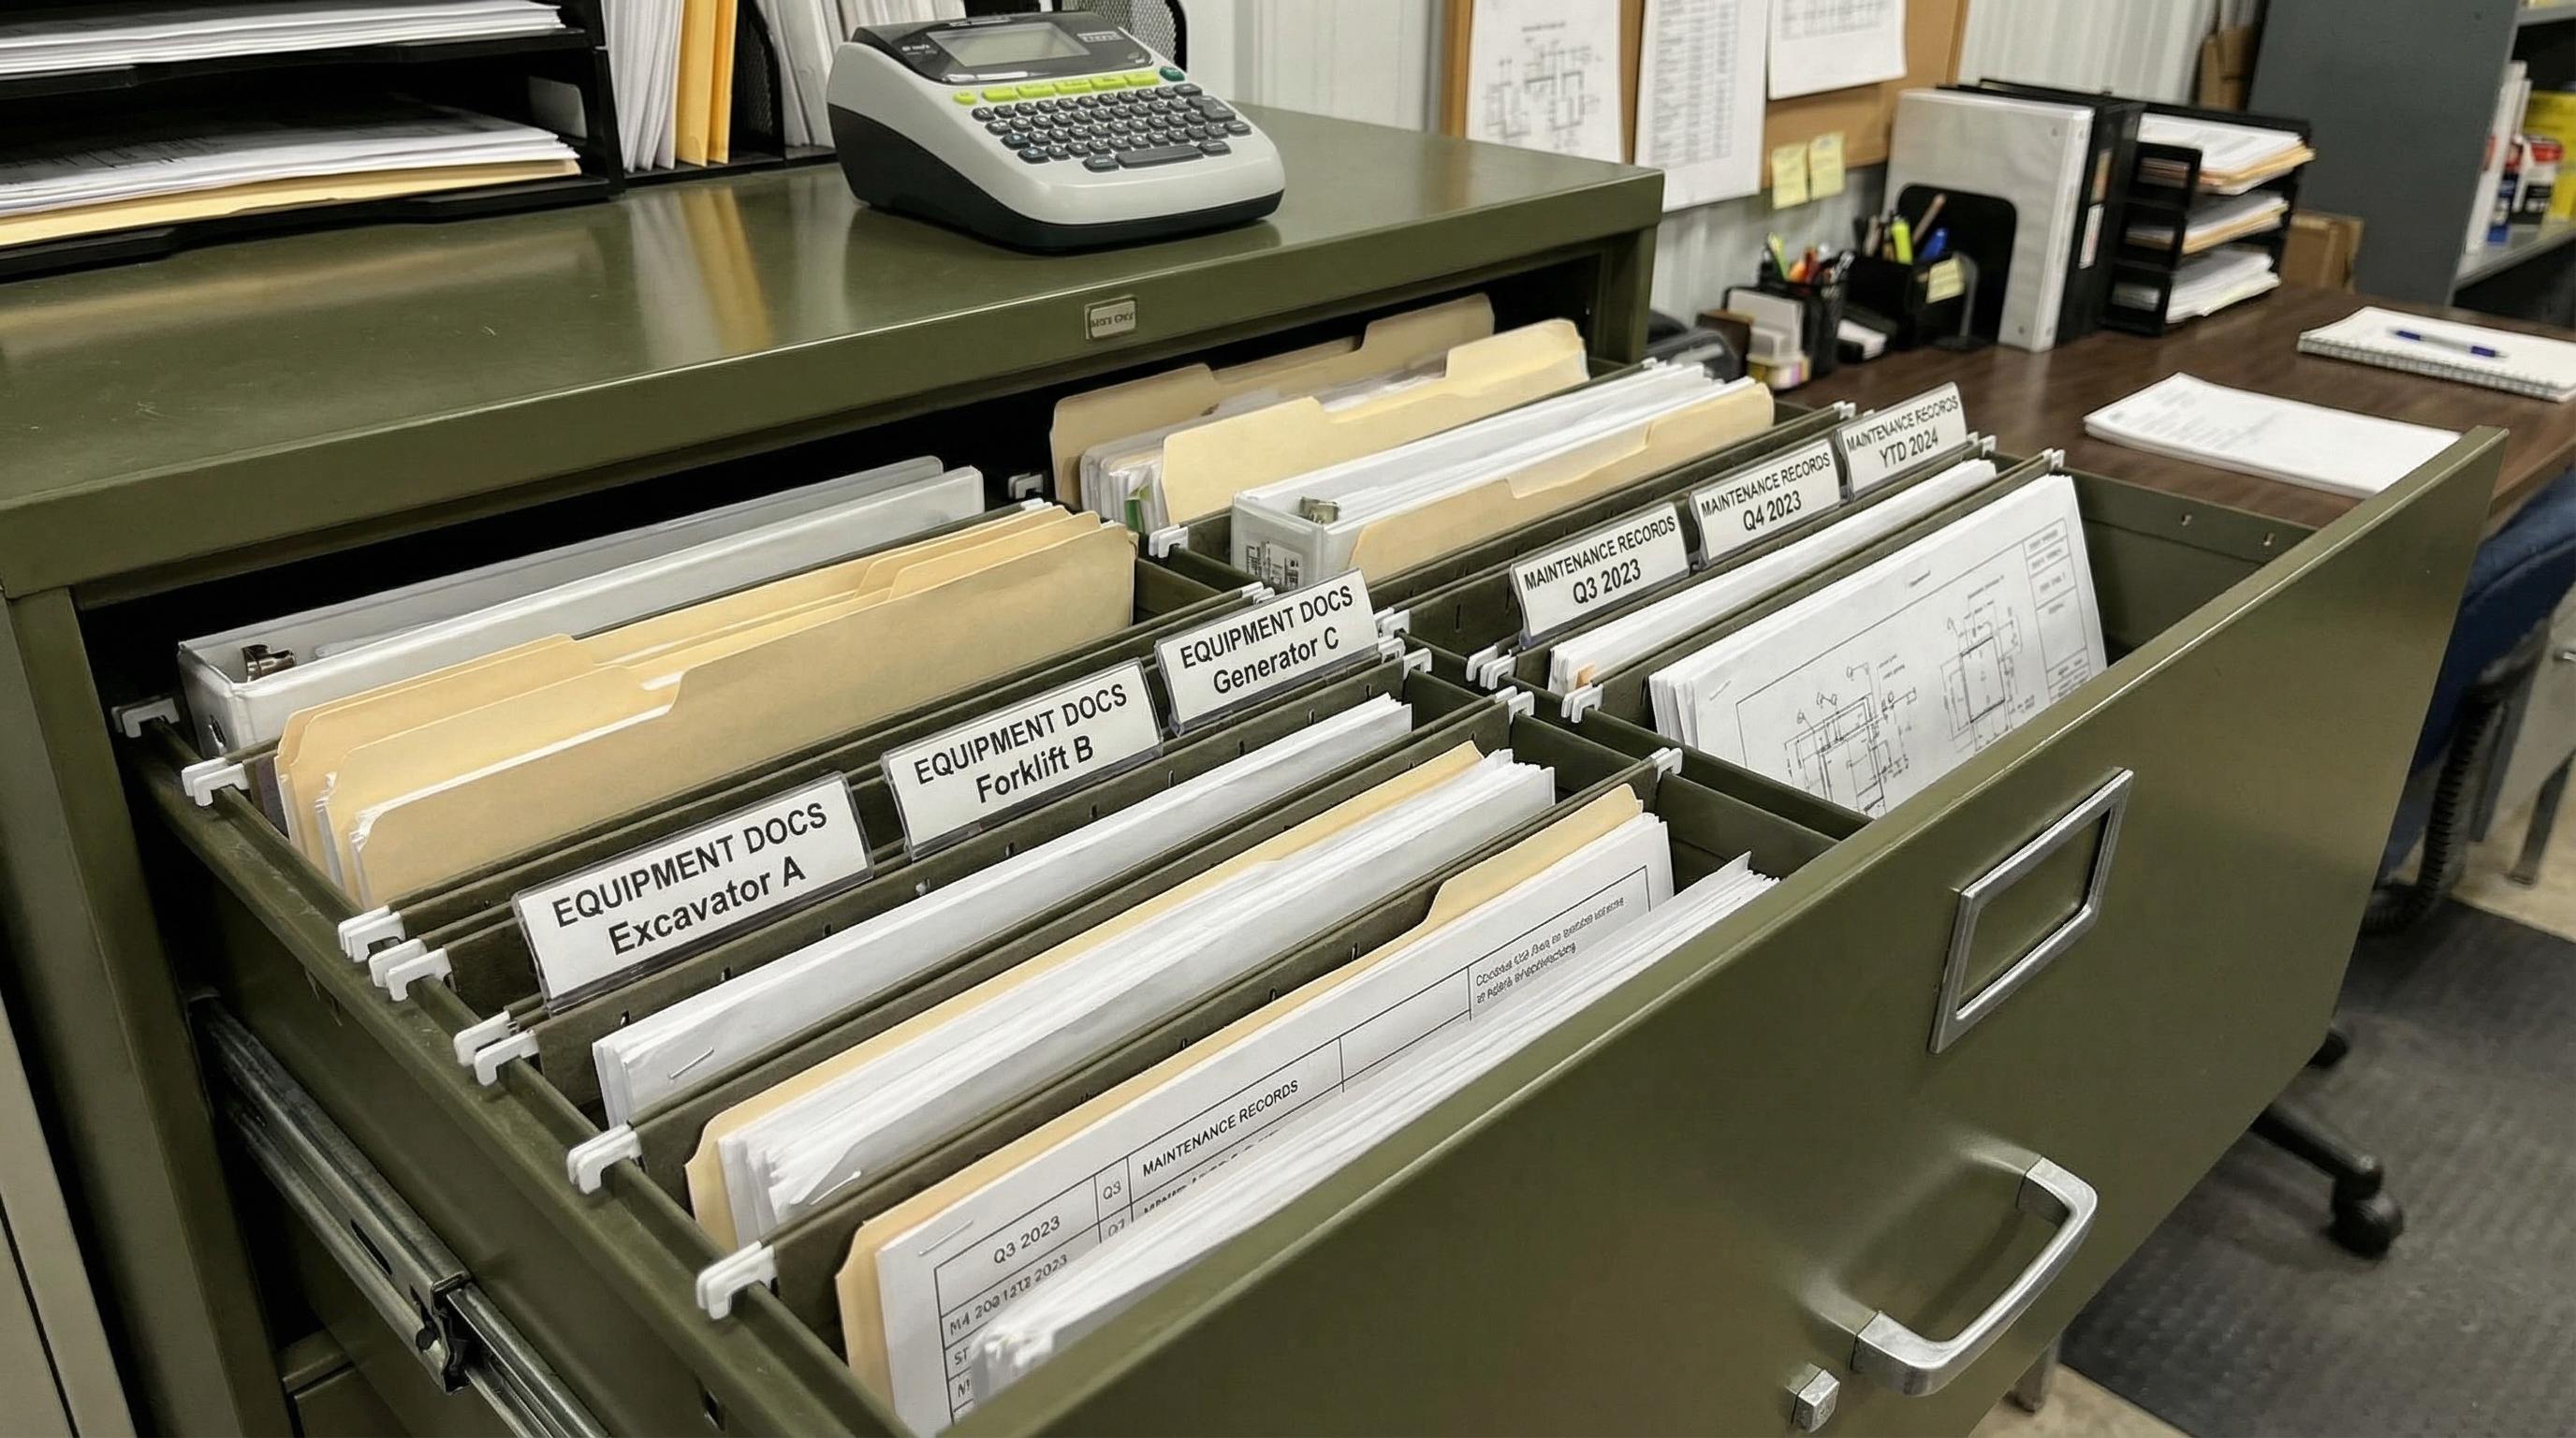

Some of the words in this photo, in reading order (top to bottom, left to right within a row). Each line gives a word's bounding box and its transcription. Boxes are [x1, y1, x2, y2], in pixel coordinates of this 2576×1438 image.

[1846, 412, 1915, 452] MAINTENANCE
[1879, 441, 1907, 468] YTD
[1910, 425, 1939, 457] 2024
[1701, 473, 1779, 518] MAINTENANCE
[1780, 452, 1831, 486] RECORDS
[1743, 505, 1764, 531] Q4
[1767, 491, 1802, 521] 2023
[1524, 540, 1617, 591] MAINTENANCE
[1617, 516, 1676, 553] RECORDS
[1573, 577, 1598, 604] Q3
[1601, 559, 1641, 594] 2023
[1180, 607, 1295, 668] EQUIPMENT
[1299, 585, 1353, 623] DOCS
[1213, 638, 1318, 694] Generator
[1324, 626, 1339, 650] C
[914, 710, 1055, 785] EQUIPMENT
[1061, 683, 1127, 726] DOCS
[976, 747, 1069, 803] Forklift
[1074, 735, 1093, 763] B
[552, 835, 733, 927] EQUIPMENT
[743, 802, 827, 854] DOCS
[608, 873, 770, 955] Excavator
[783, 856, 806, 888] A
[1143, 1114, 1237, 1177] MAINTENANCE
[1238, 1079, 1298, 1123] RECORDS
[1103, 1181, 1121, 1200] Q3
[993, 1242, 1016, 1264] Q3
[1020, 1215, 1061, 1250] 2023
[1035, 1254, 1068, 1283] 2023
